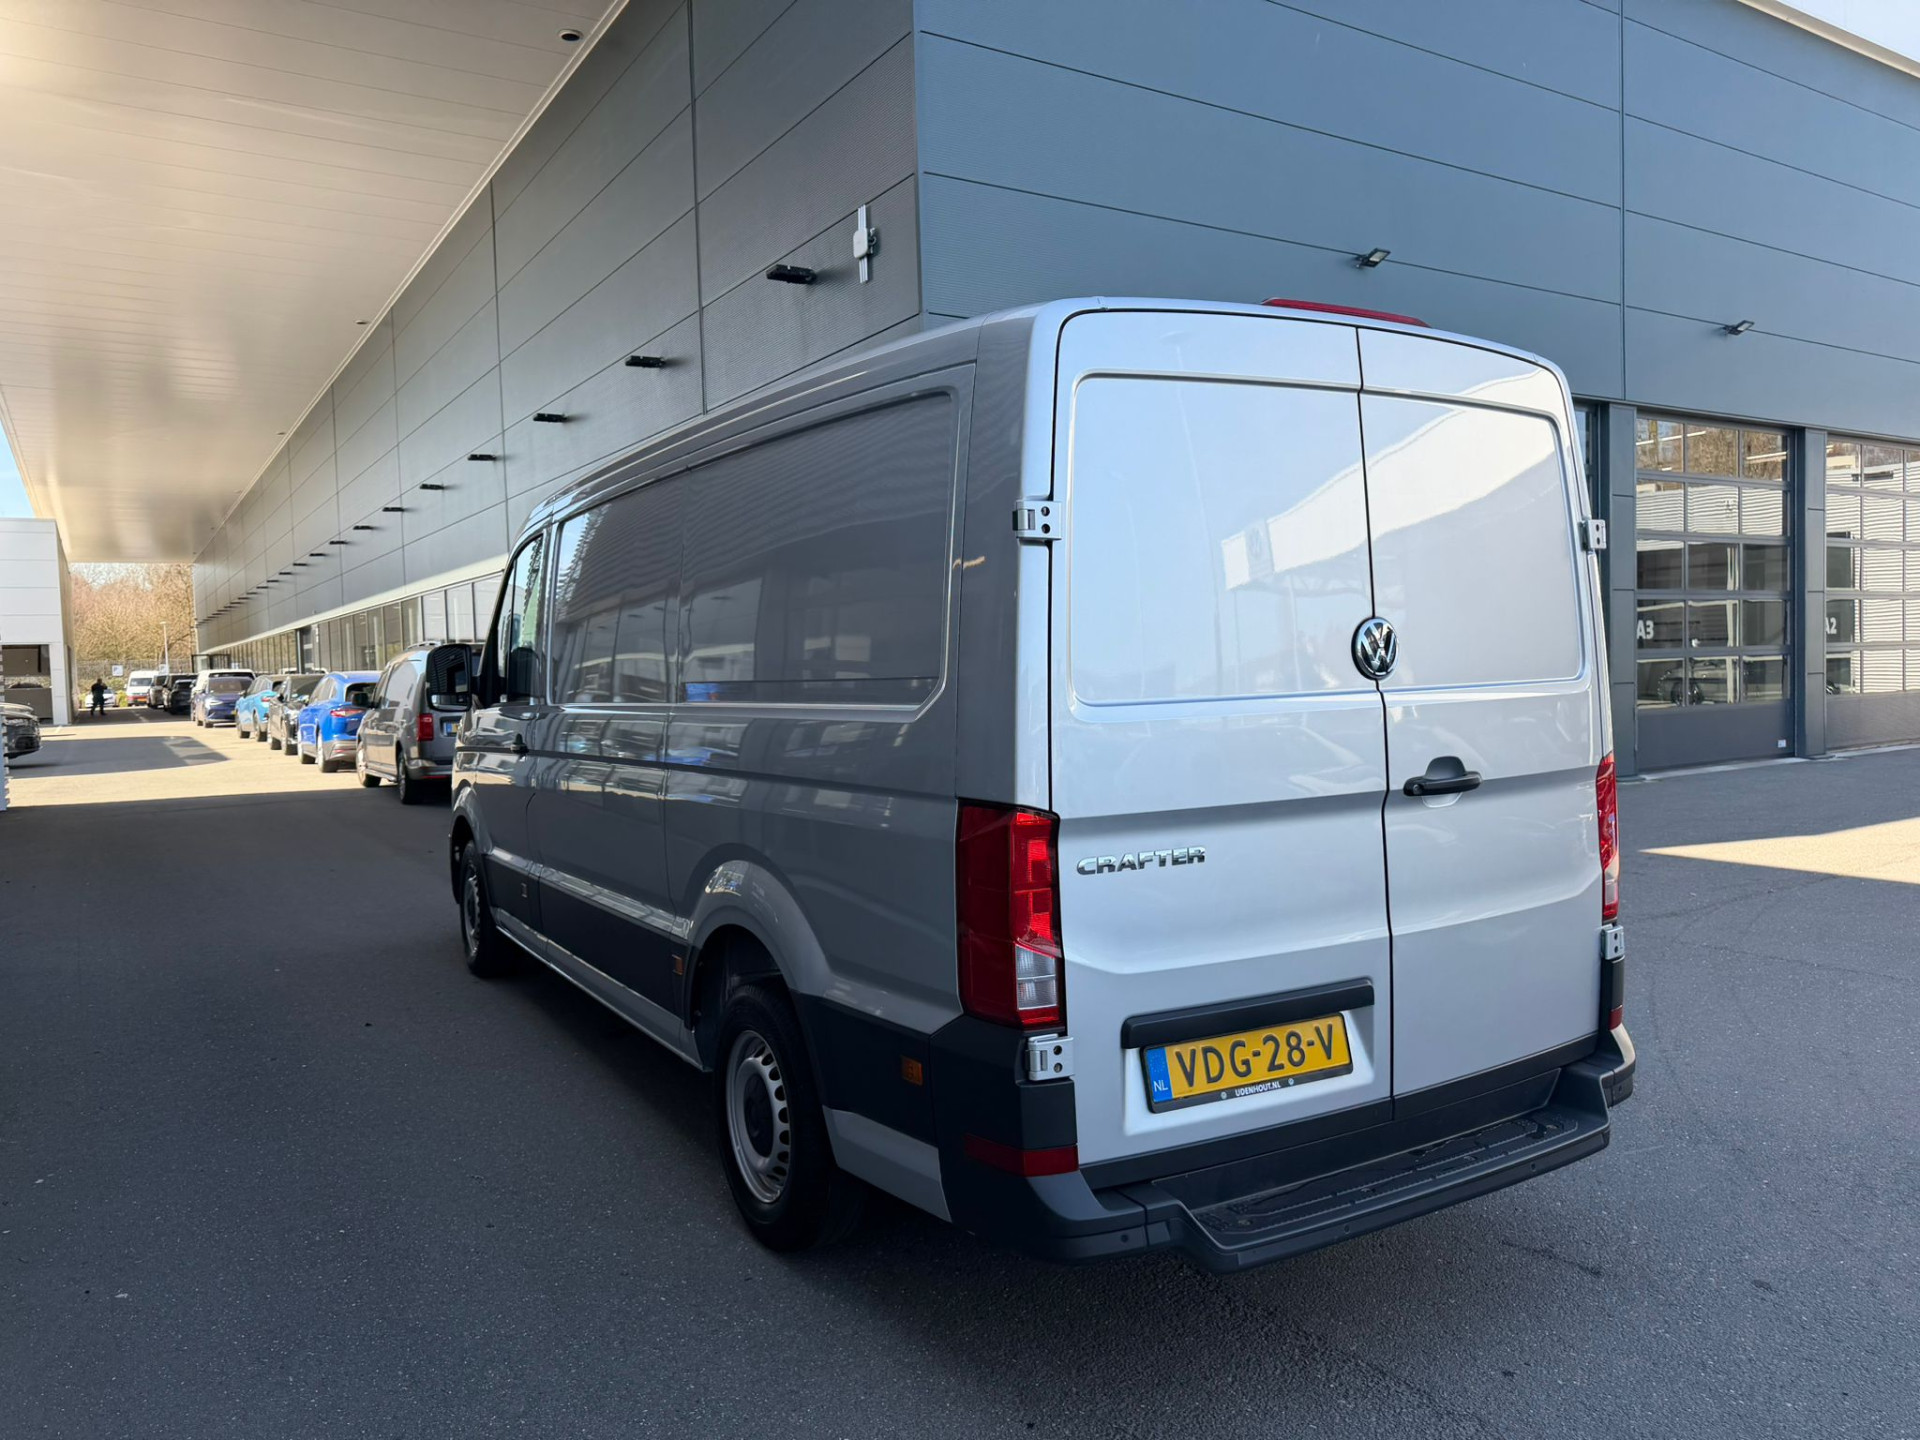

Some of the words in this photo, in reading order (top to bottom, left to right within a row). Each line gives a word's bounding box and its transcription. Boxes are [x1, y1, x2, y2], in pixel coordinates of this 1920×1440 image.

[1636, 619, 1654, 640] A3
[1354, 617, 1399, 679] VW
[1076, 846, 1206, 876] CRAFTER
[1174, 1022, 1334, 1088] VDG-28-V
[1153, 1079, 1169, 1093] NL
[1234, 1080, 1282, 1098] UDENHOUT.NL
